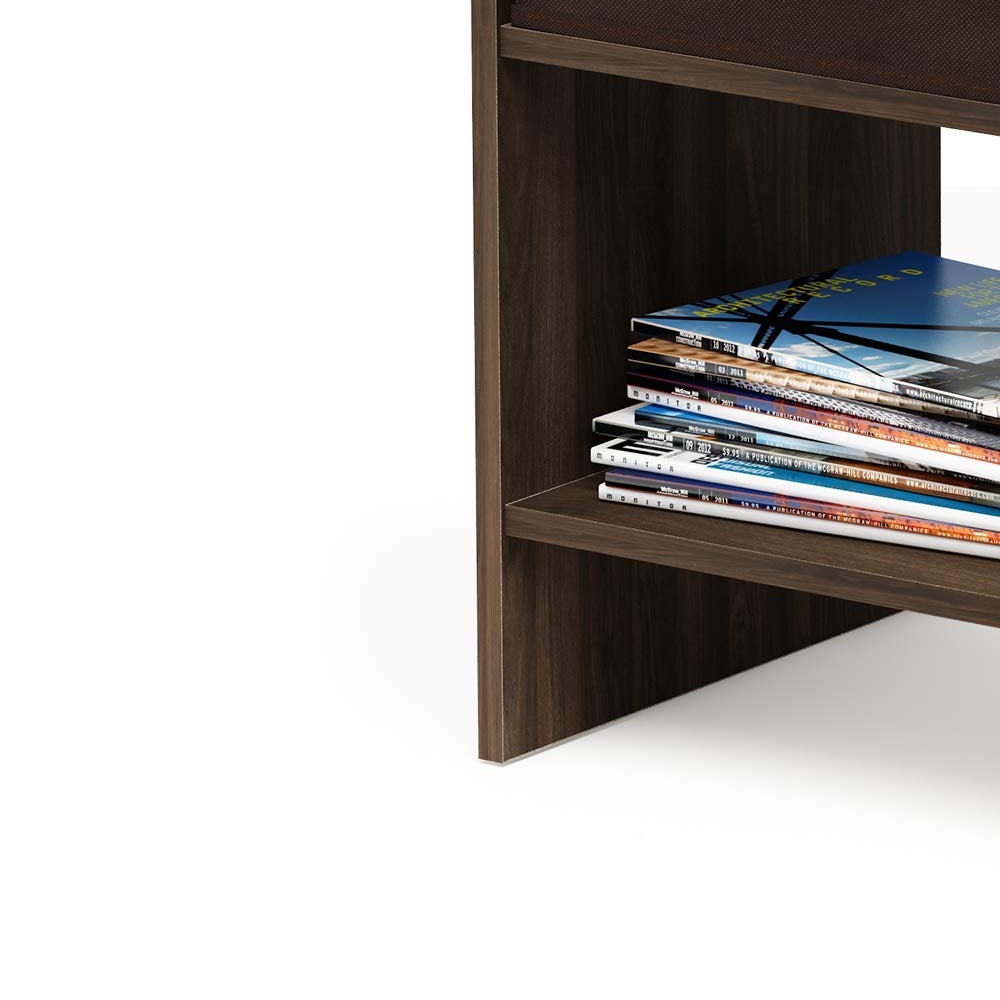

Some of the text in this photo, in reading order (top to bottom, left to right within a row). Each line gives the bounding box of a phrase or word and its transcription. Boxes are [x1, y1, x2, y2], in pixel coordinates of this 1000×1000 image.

[693, 276, 859, 318] ARCHITECTURAL
[783, 268, 924, 305] RECORD
[712, 340, 736, 353] 10 2012
[772, 410, 810, 423] PUBLICATION
[685, 440, 694, 451] 09
[697, 441, 712, 454] 2012
[722, 447, 740, 458] $9.95
[751, 453, 792, 467] PUBLICATION
[793, 459, 801, 468] OF
[804, 460, 816, 471] THE
[818, 462, 861, 478] MCGRAW-HILL
[862, 471, 898, 485] COMPANIES
[741, 501, 760, 509] $9.95
[772, 506, 816, 517] PUBLICATION
[843, 516, 889, 528] MCGRAW-HILL
[890, 523, 929, 535] COMPANIES
